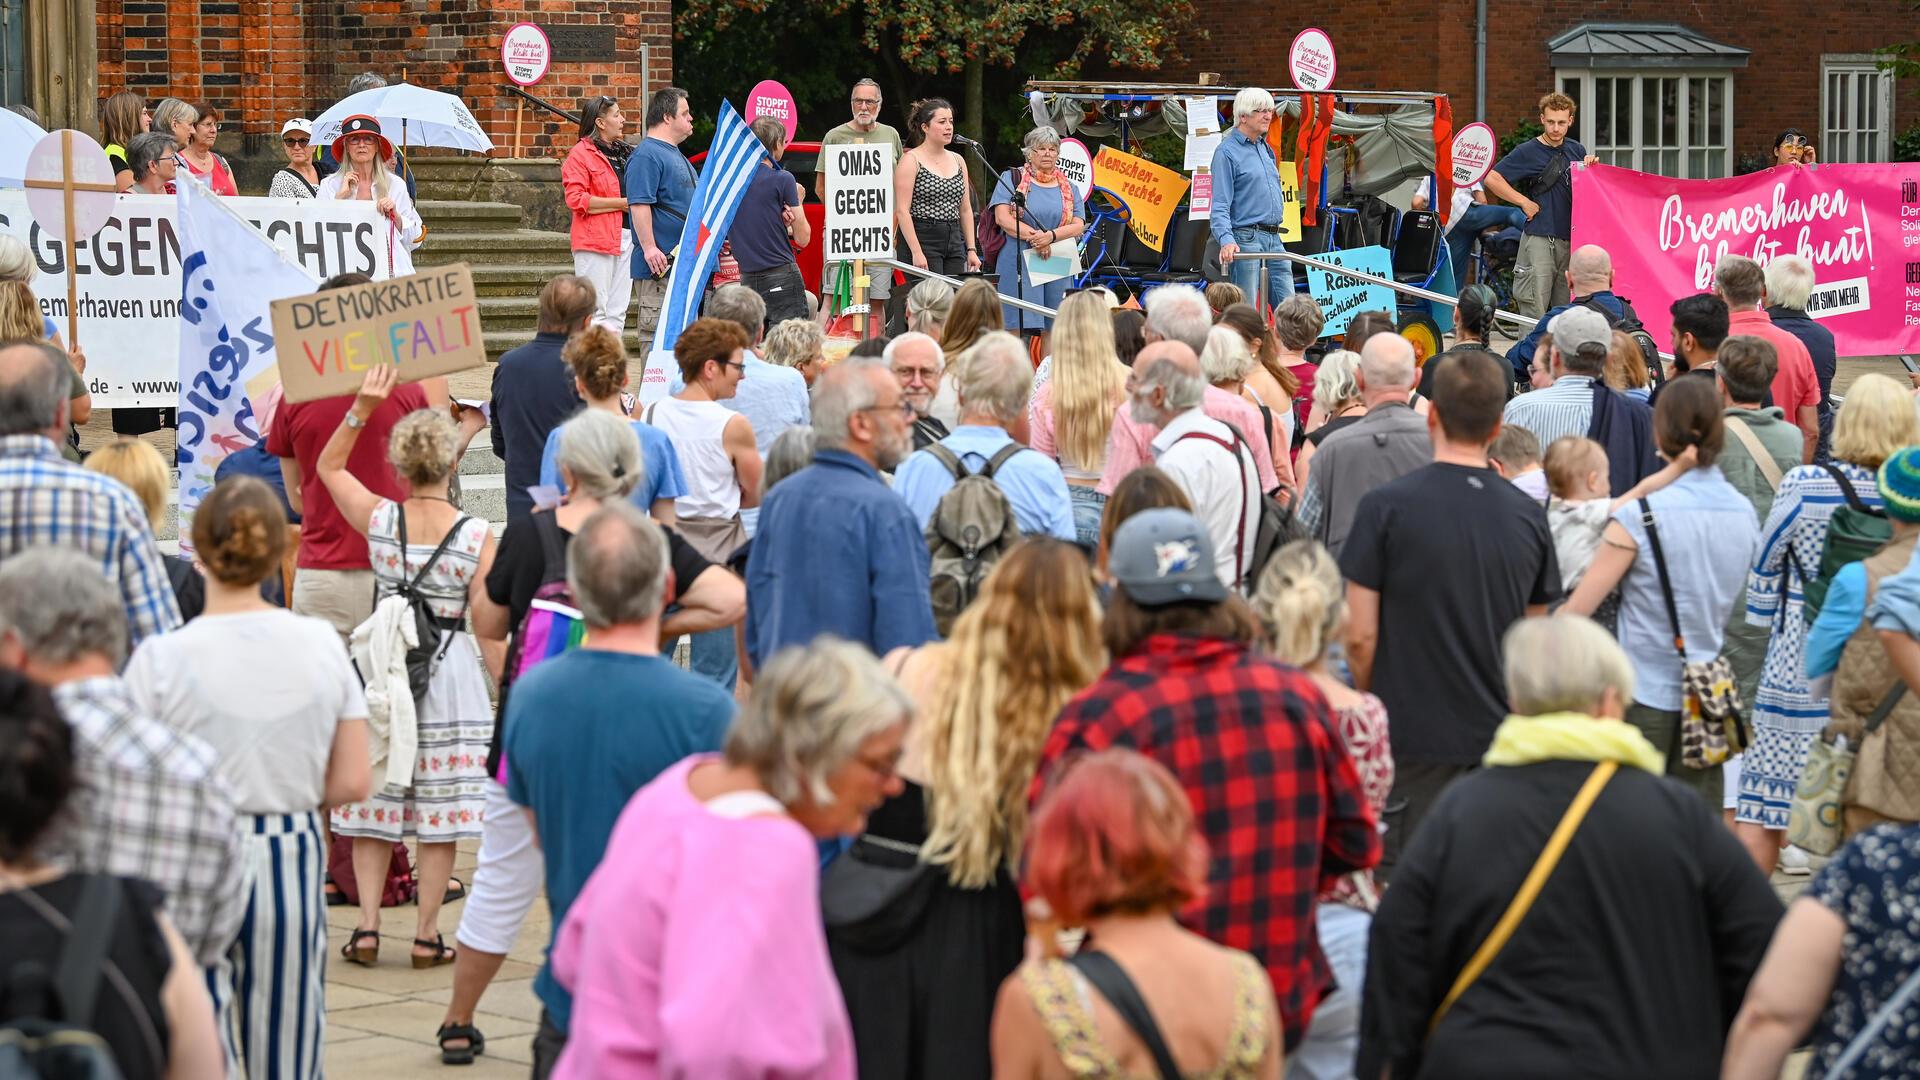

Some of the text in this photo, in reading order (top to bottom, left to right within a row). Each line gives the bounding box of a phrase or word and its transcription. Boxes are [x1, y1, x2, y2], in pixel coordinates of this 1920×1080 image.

[755, 106, 789, 120] RECHTS!
[756, 96, 788, 109] STOPPT
[838, 150, 882, 177] OMAS
[1055, 157, 1086, 173] STOPPT
[1059, 166, 1086, 183] CHTS!
[1097, 151, 1159, 183] Menschen-
[835, 189, 886, 215] GEGEN
[1121, 181, 1163, 211] rechte
[1901, 178, 1918, 203] FÜR
[1659, 182, 1848, 251] Bremerhaven
[831, 226, 890, 253] RECHTS
[1797, 198, 1875, 271] bunt!
[248, 219, 376, 279] CHTS
[292, 272, 463, 330] DEMOKRATIE
[1316, 294, 1333, 307] sind
[1324, 290, 1368, 323] rschlöcher
[1820, 288, 1838, 310] SIND
[1838, 286, 1860, 307] MEHR
[302, 305, 474, 376] VIELFALT
